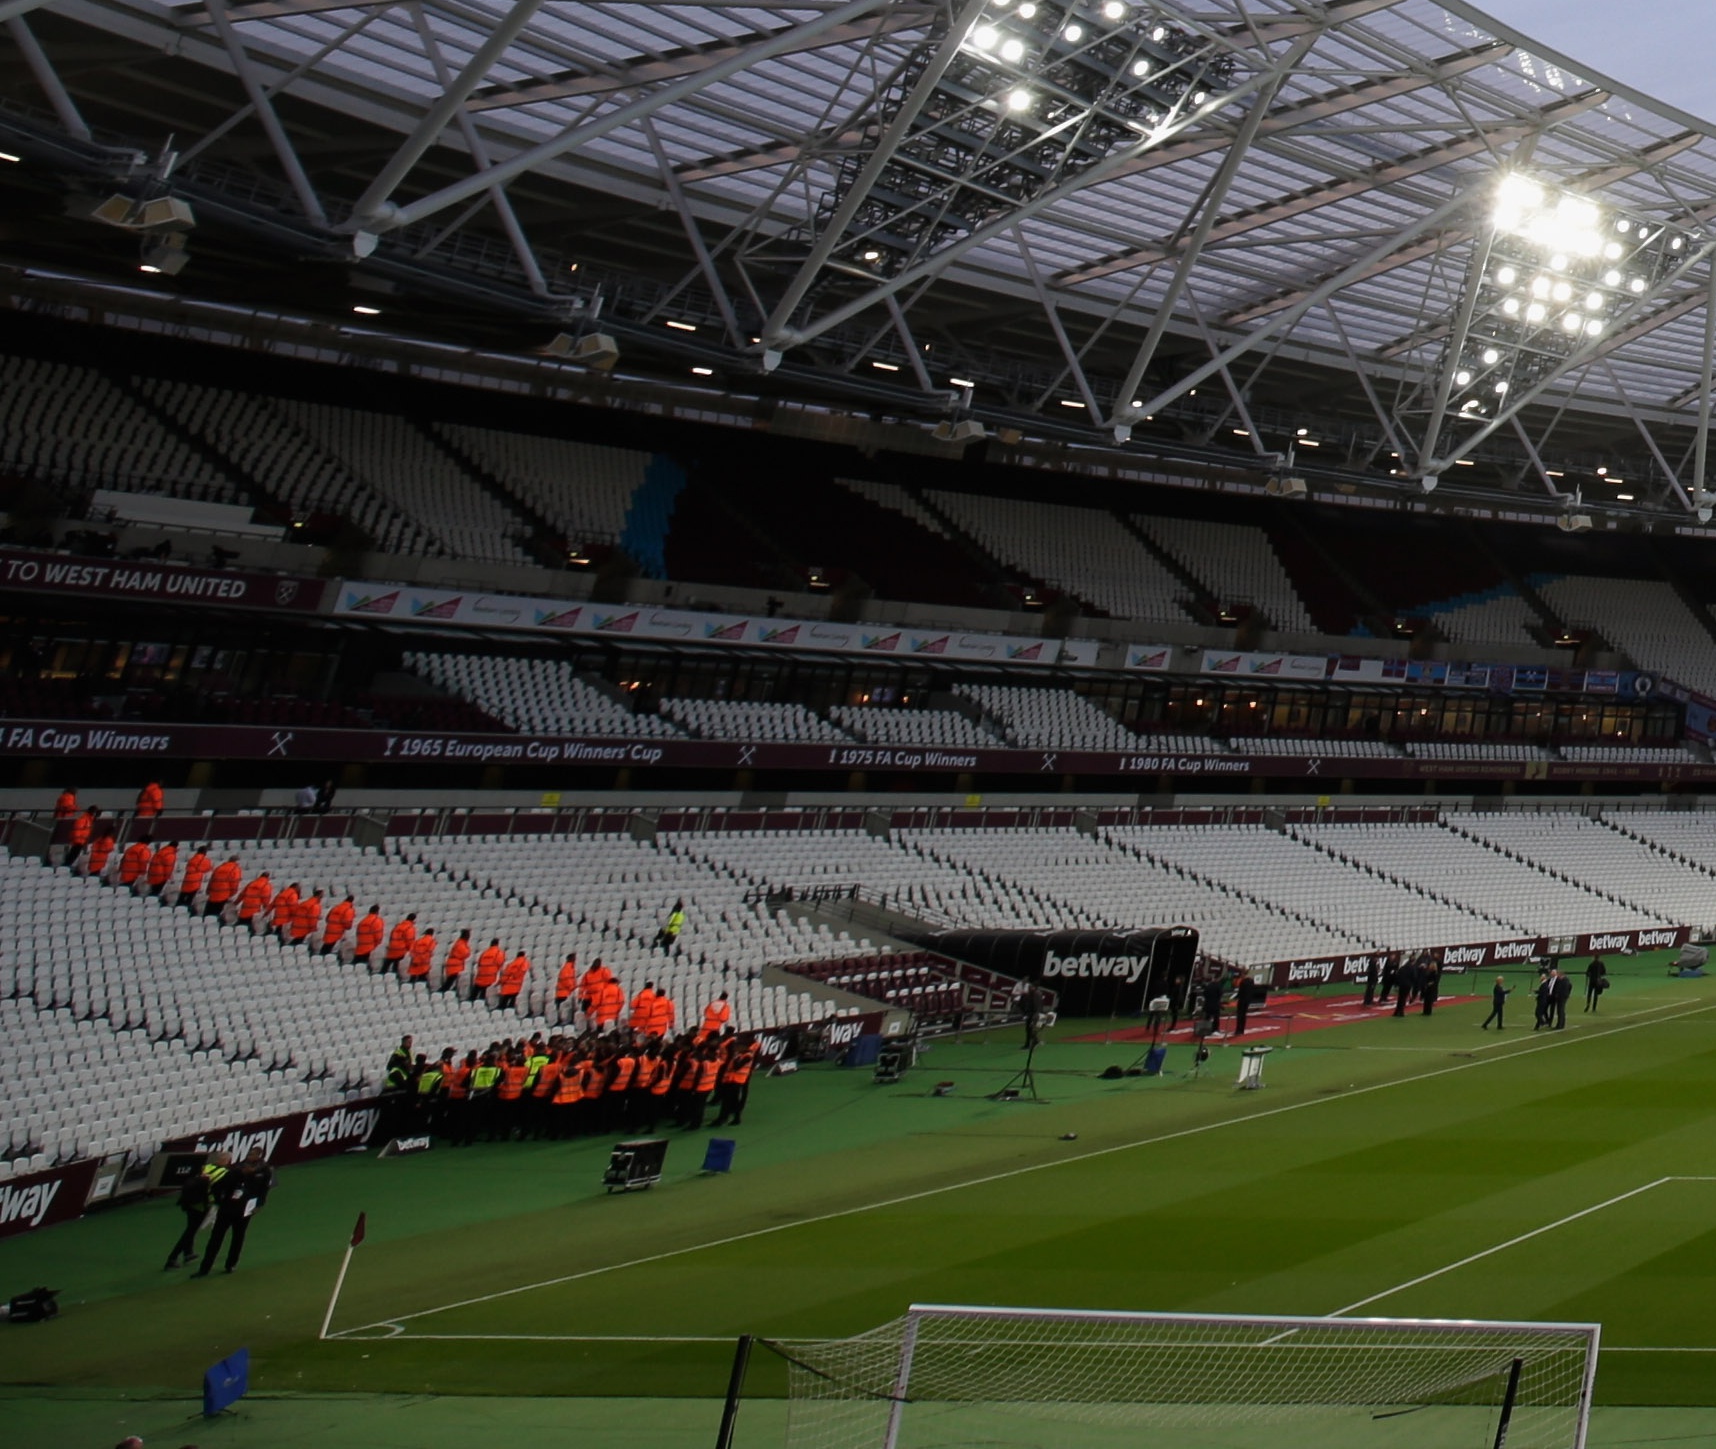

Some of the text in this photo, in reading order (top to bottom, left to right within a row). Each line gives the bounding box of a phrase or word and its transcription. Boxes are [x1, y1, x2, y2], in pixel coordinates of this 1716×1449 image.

[7, 560, 38, 580] TO
[43, 563, 111, 586] WEST
[109, 569, 162, 592] HAM
[166, 575, 247, 599] UNITED
[7, 728, 34, 748] FA
[39, 729, 82, 753] Cup
[86, 730, 170, 751] Winners
[399, 738, 443, 756] 1965
[445, 739, 523, 761] European
[526, 741, 559, 762] Cup
[631, 745, 663, 765] Cup
[840, 750, 977, 769] 1975 FA Cup Winners
[1128, 756, 1250, 774] 1980 FA Cup Winners
[1589, 932, 1630, 952] betway
[1638, 929, 1678, 947] betway
[1443, 944, 1487, 966] betway
[1493, 940, 1536, 962] betway
[1043, 950, 1149, 984] betway
[299, 1107, 381, 1149] betway
